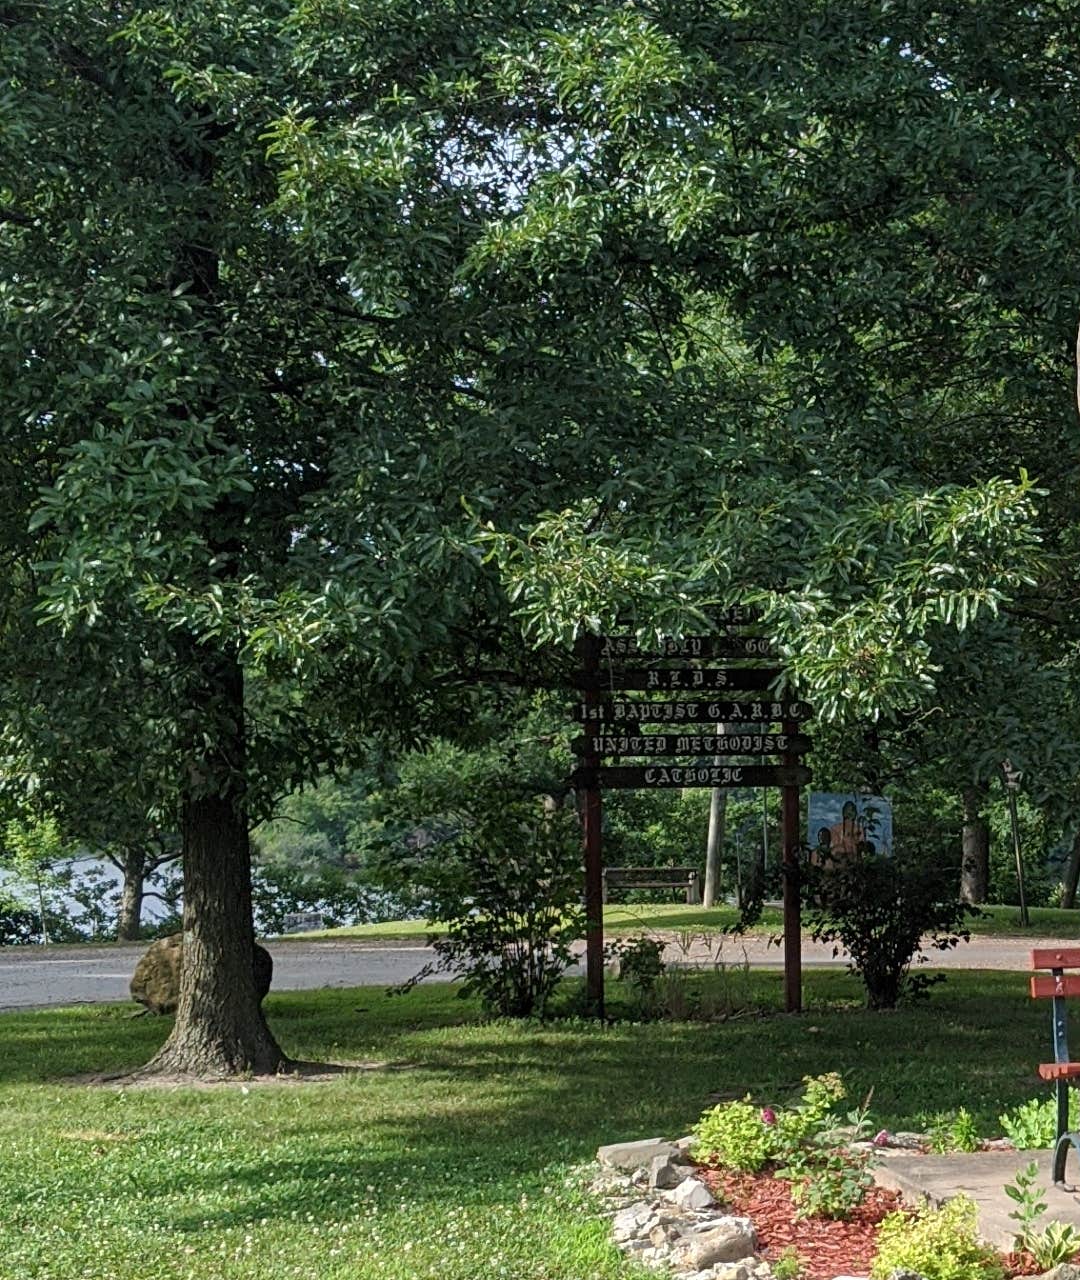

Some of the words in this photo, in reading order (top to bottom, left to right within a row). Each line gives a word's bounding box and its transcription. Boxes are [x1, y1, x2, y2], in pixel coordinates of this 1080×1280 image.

[647, 670, 735, 688] R.L.D.S.
[580, 704, 604, 720] 1st
[614, 702, 699, 721] BAPTIST
[708, 702, 806, 721] G.A.R.B.C.
[592, 736, 667, 754] UNITED
[675, 735, 789, 754] METHODIST
[644, 767, 744, 786] CATHOLIC
